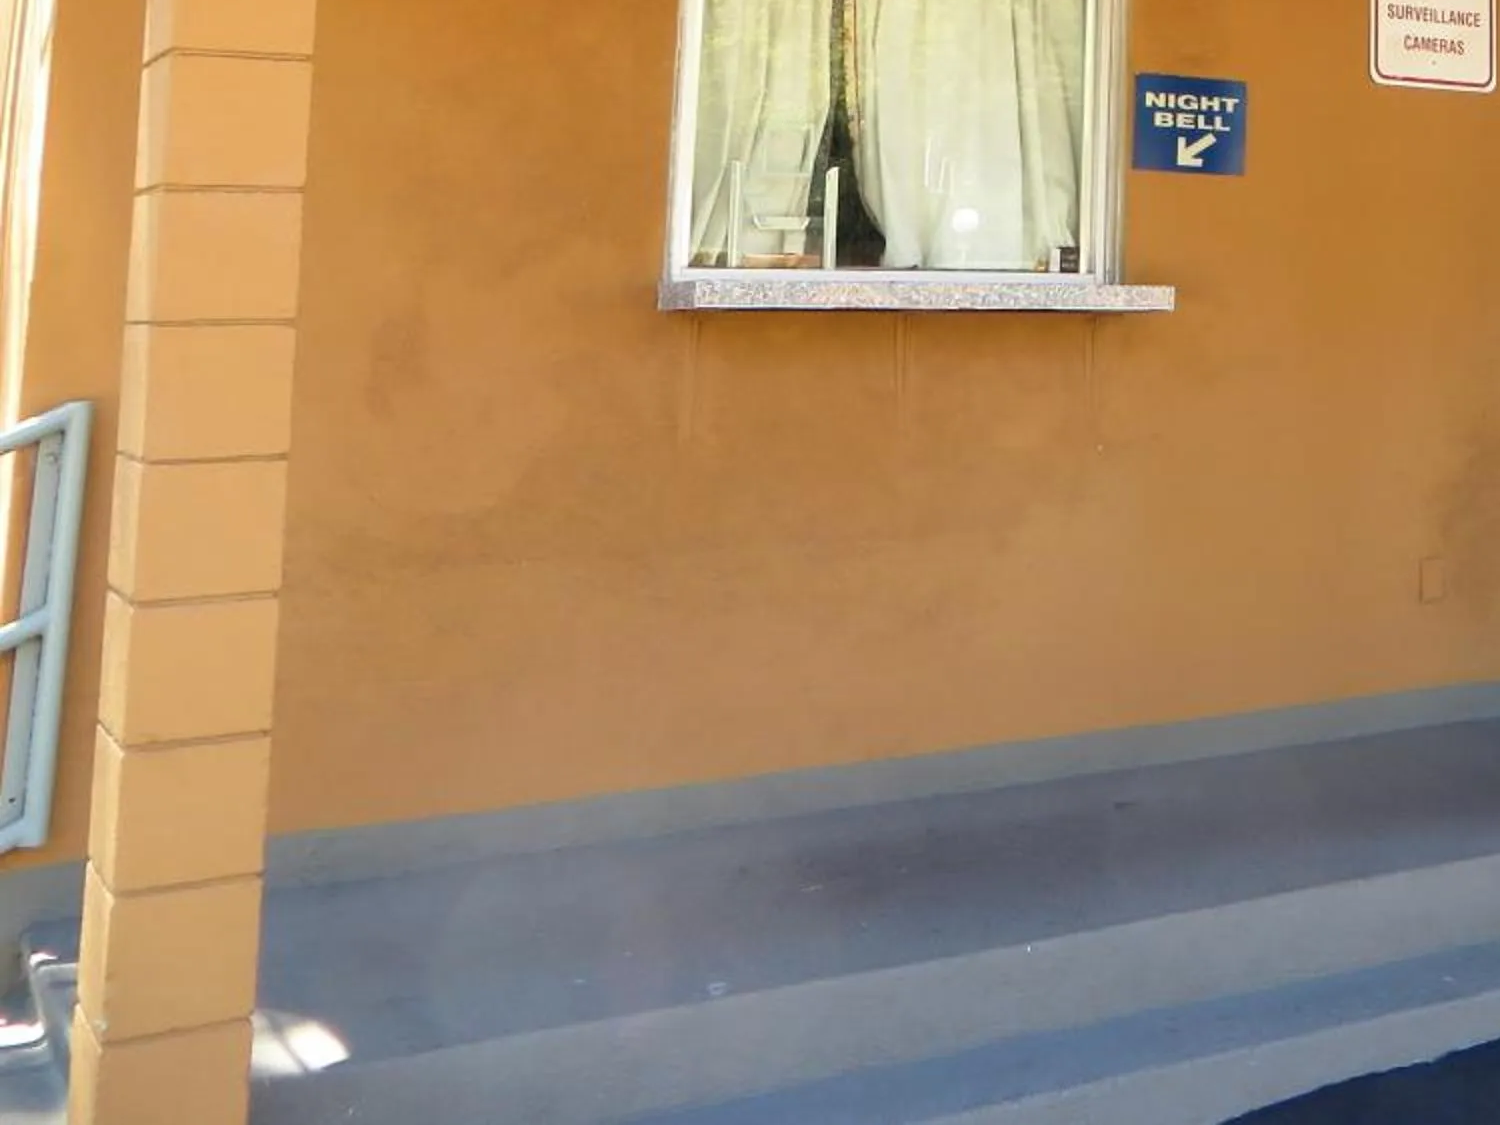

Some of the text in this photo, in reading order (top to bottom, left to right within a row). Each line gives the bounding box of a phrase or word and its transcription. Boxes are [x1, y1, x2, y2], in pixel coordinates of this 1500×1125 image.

[1387, 3, 1481, 27] SURVEILLANCE
[1404, 35, 1465, 55] CAMERAS
[1145, 91, 1240, 113] NIGHT
[1153, 111, 1231, 131] BELL
